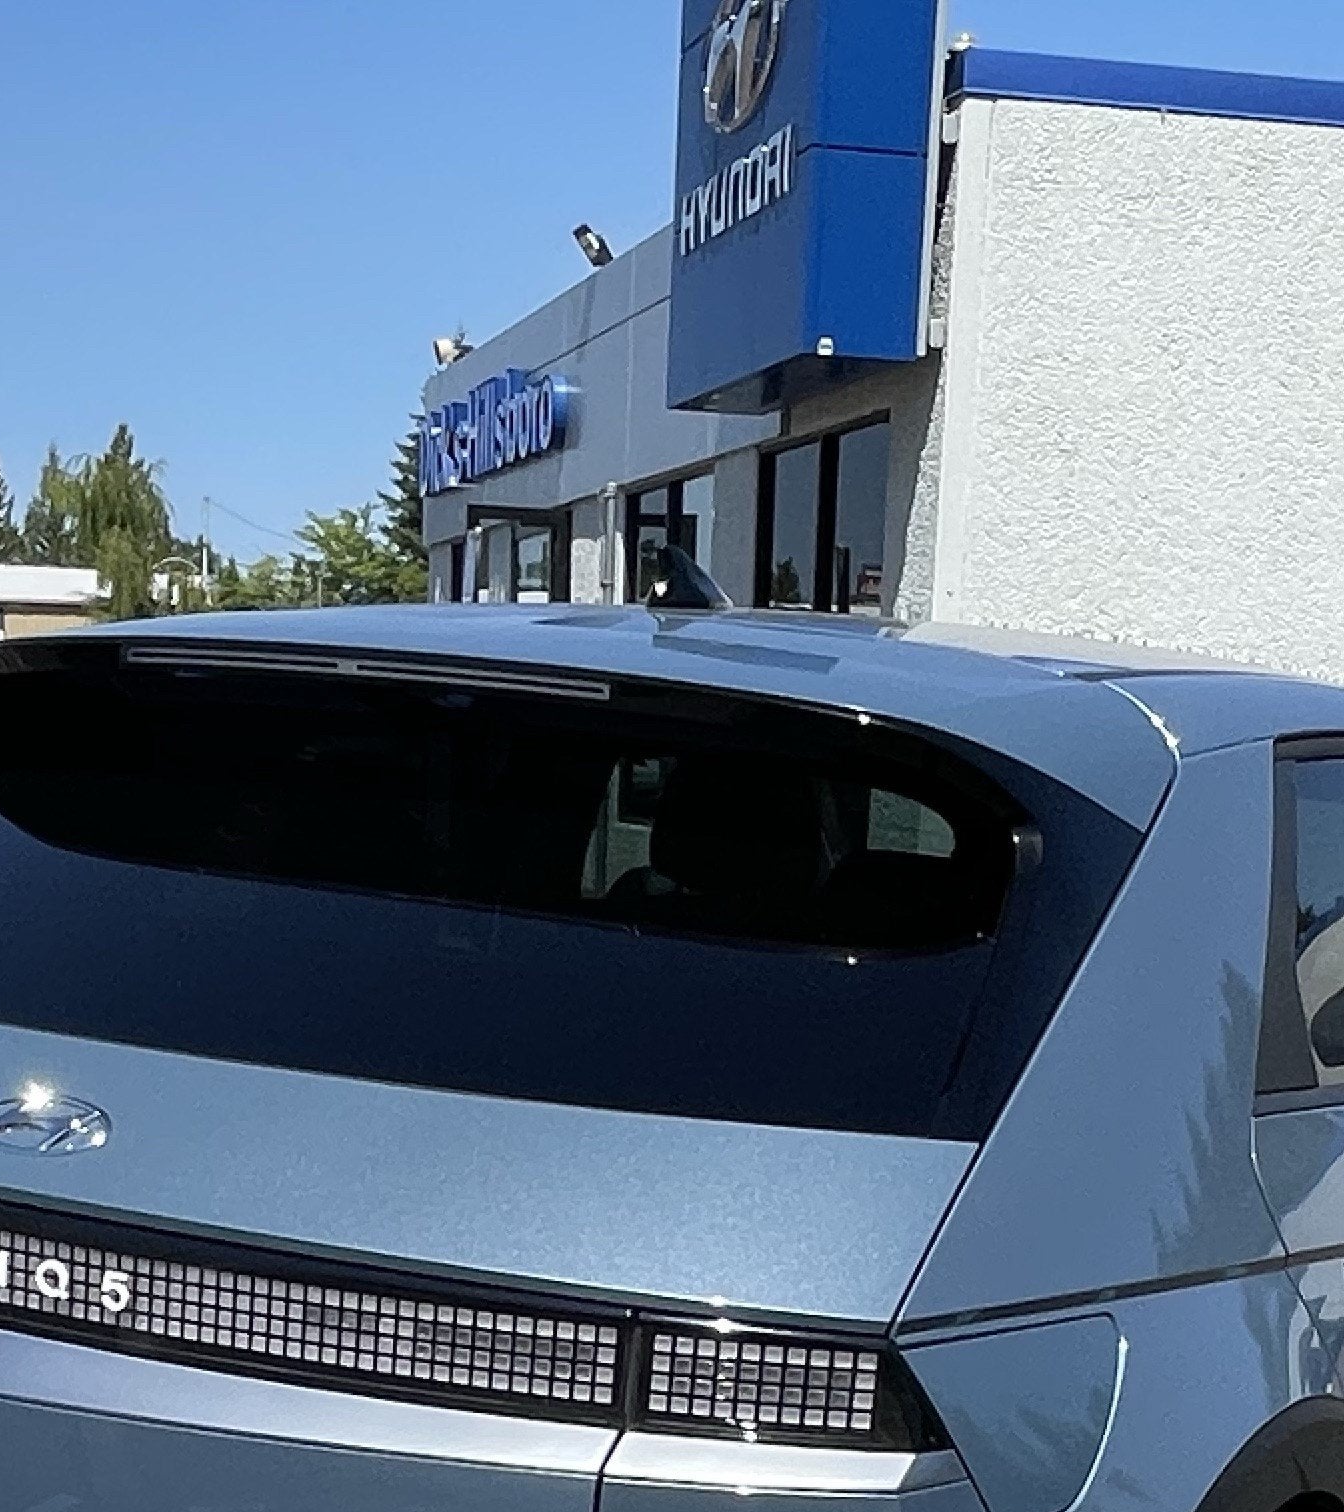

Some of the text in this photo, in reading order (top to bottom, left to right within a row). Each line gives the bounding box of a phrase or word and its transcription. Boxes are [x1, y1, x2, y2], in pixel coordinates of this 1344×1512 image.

[680, 122, 792, 256] HYUNDAI
[465, 369, 553, 479] Hillsboro
[101, 1271, 131, 1312] 5
